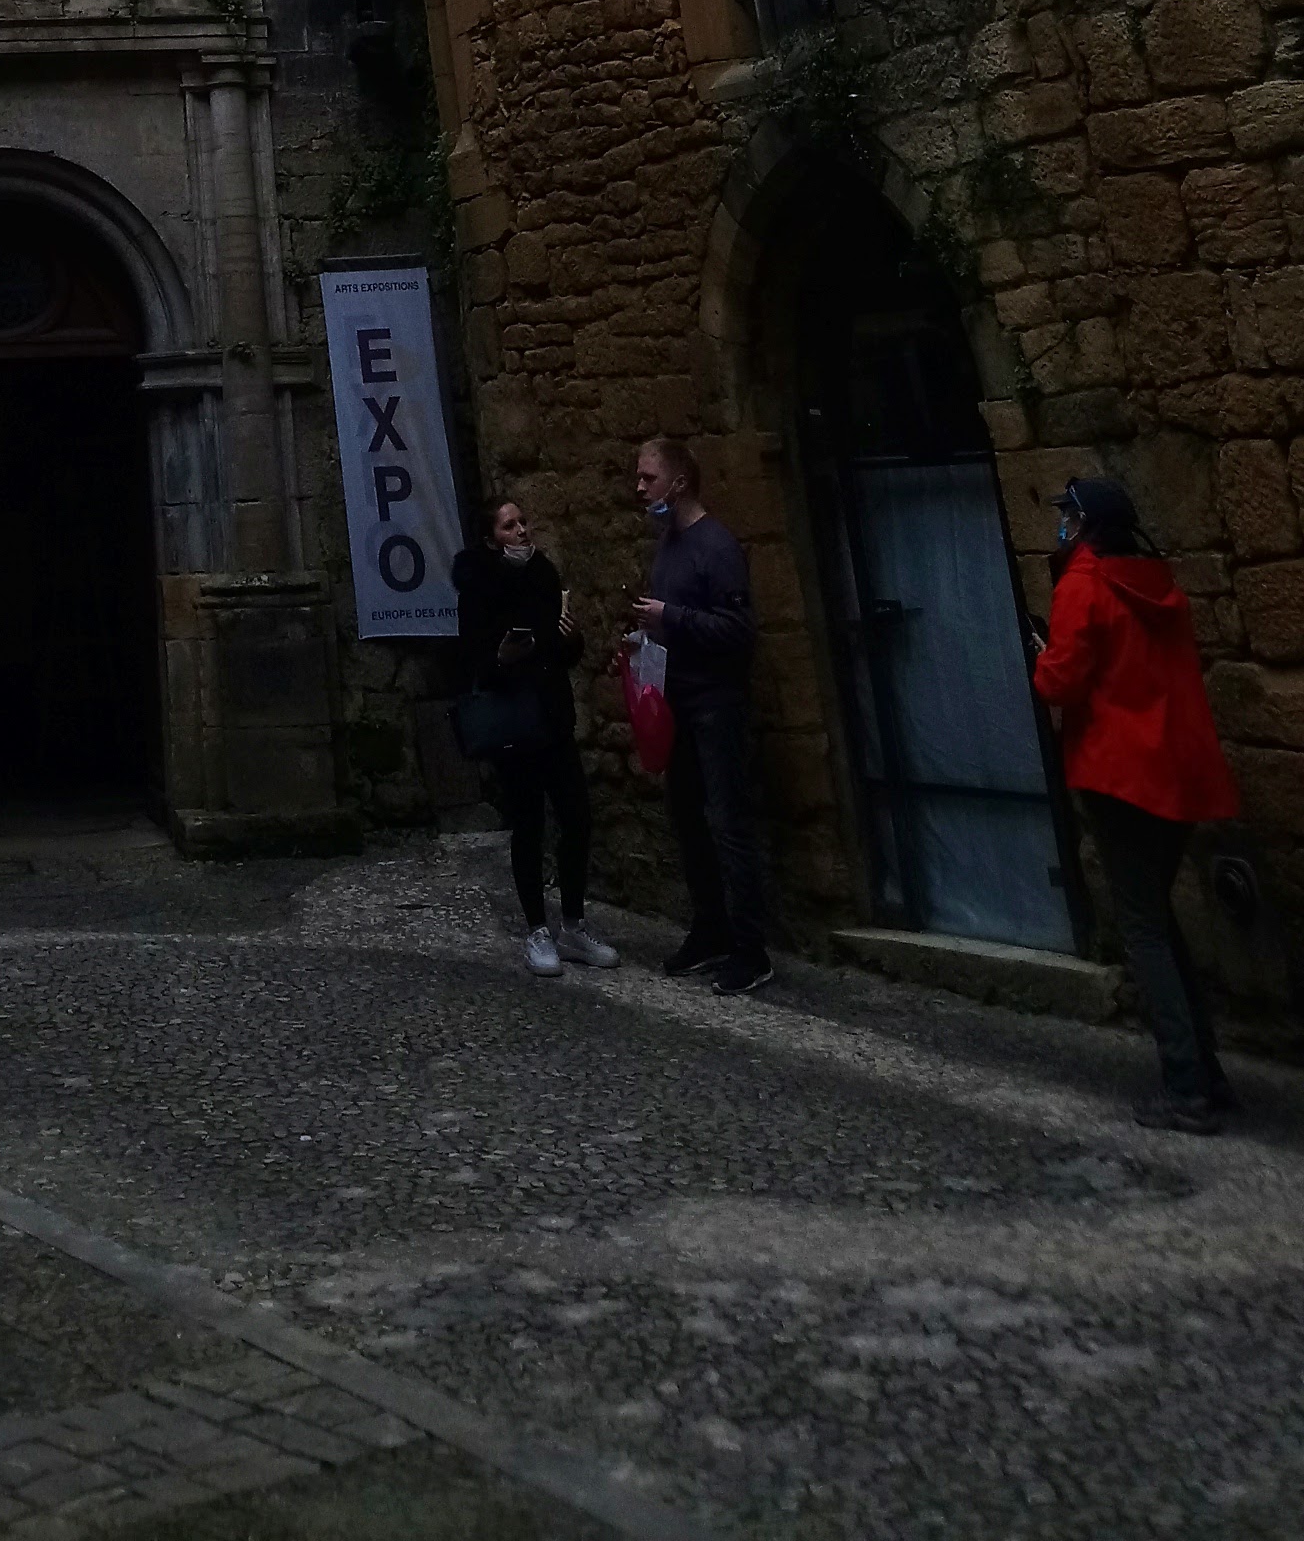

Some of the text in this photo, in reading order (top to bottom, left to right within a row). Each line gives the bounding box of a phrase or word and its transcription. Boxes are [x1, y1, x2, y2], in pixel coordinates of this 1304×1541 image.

[335, 281, 420, 294] ARTS EXPOSITIONS
[356, 328, 426, 593] EXPO
[371, 607, 459, 621] EUROPE DES ART
